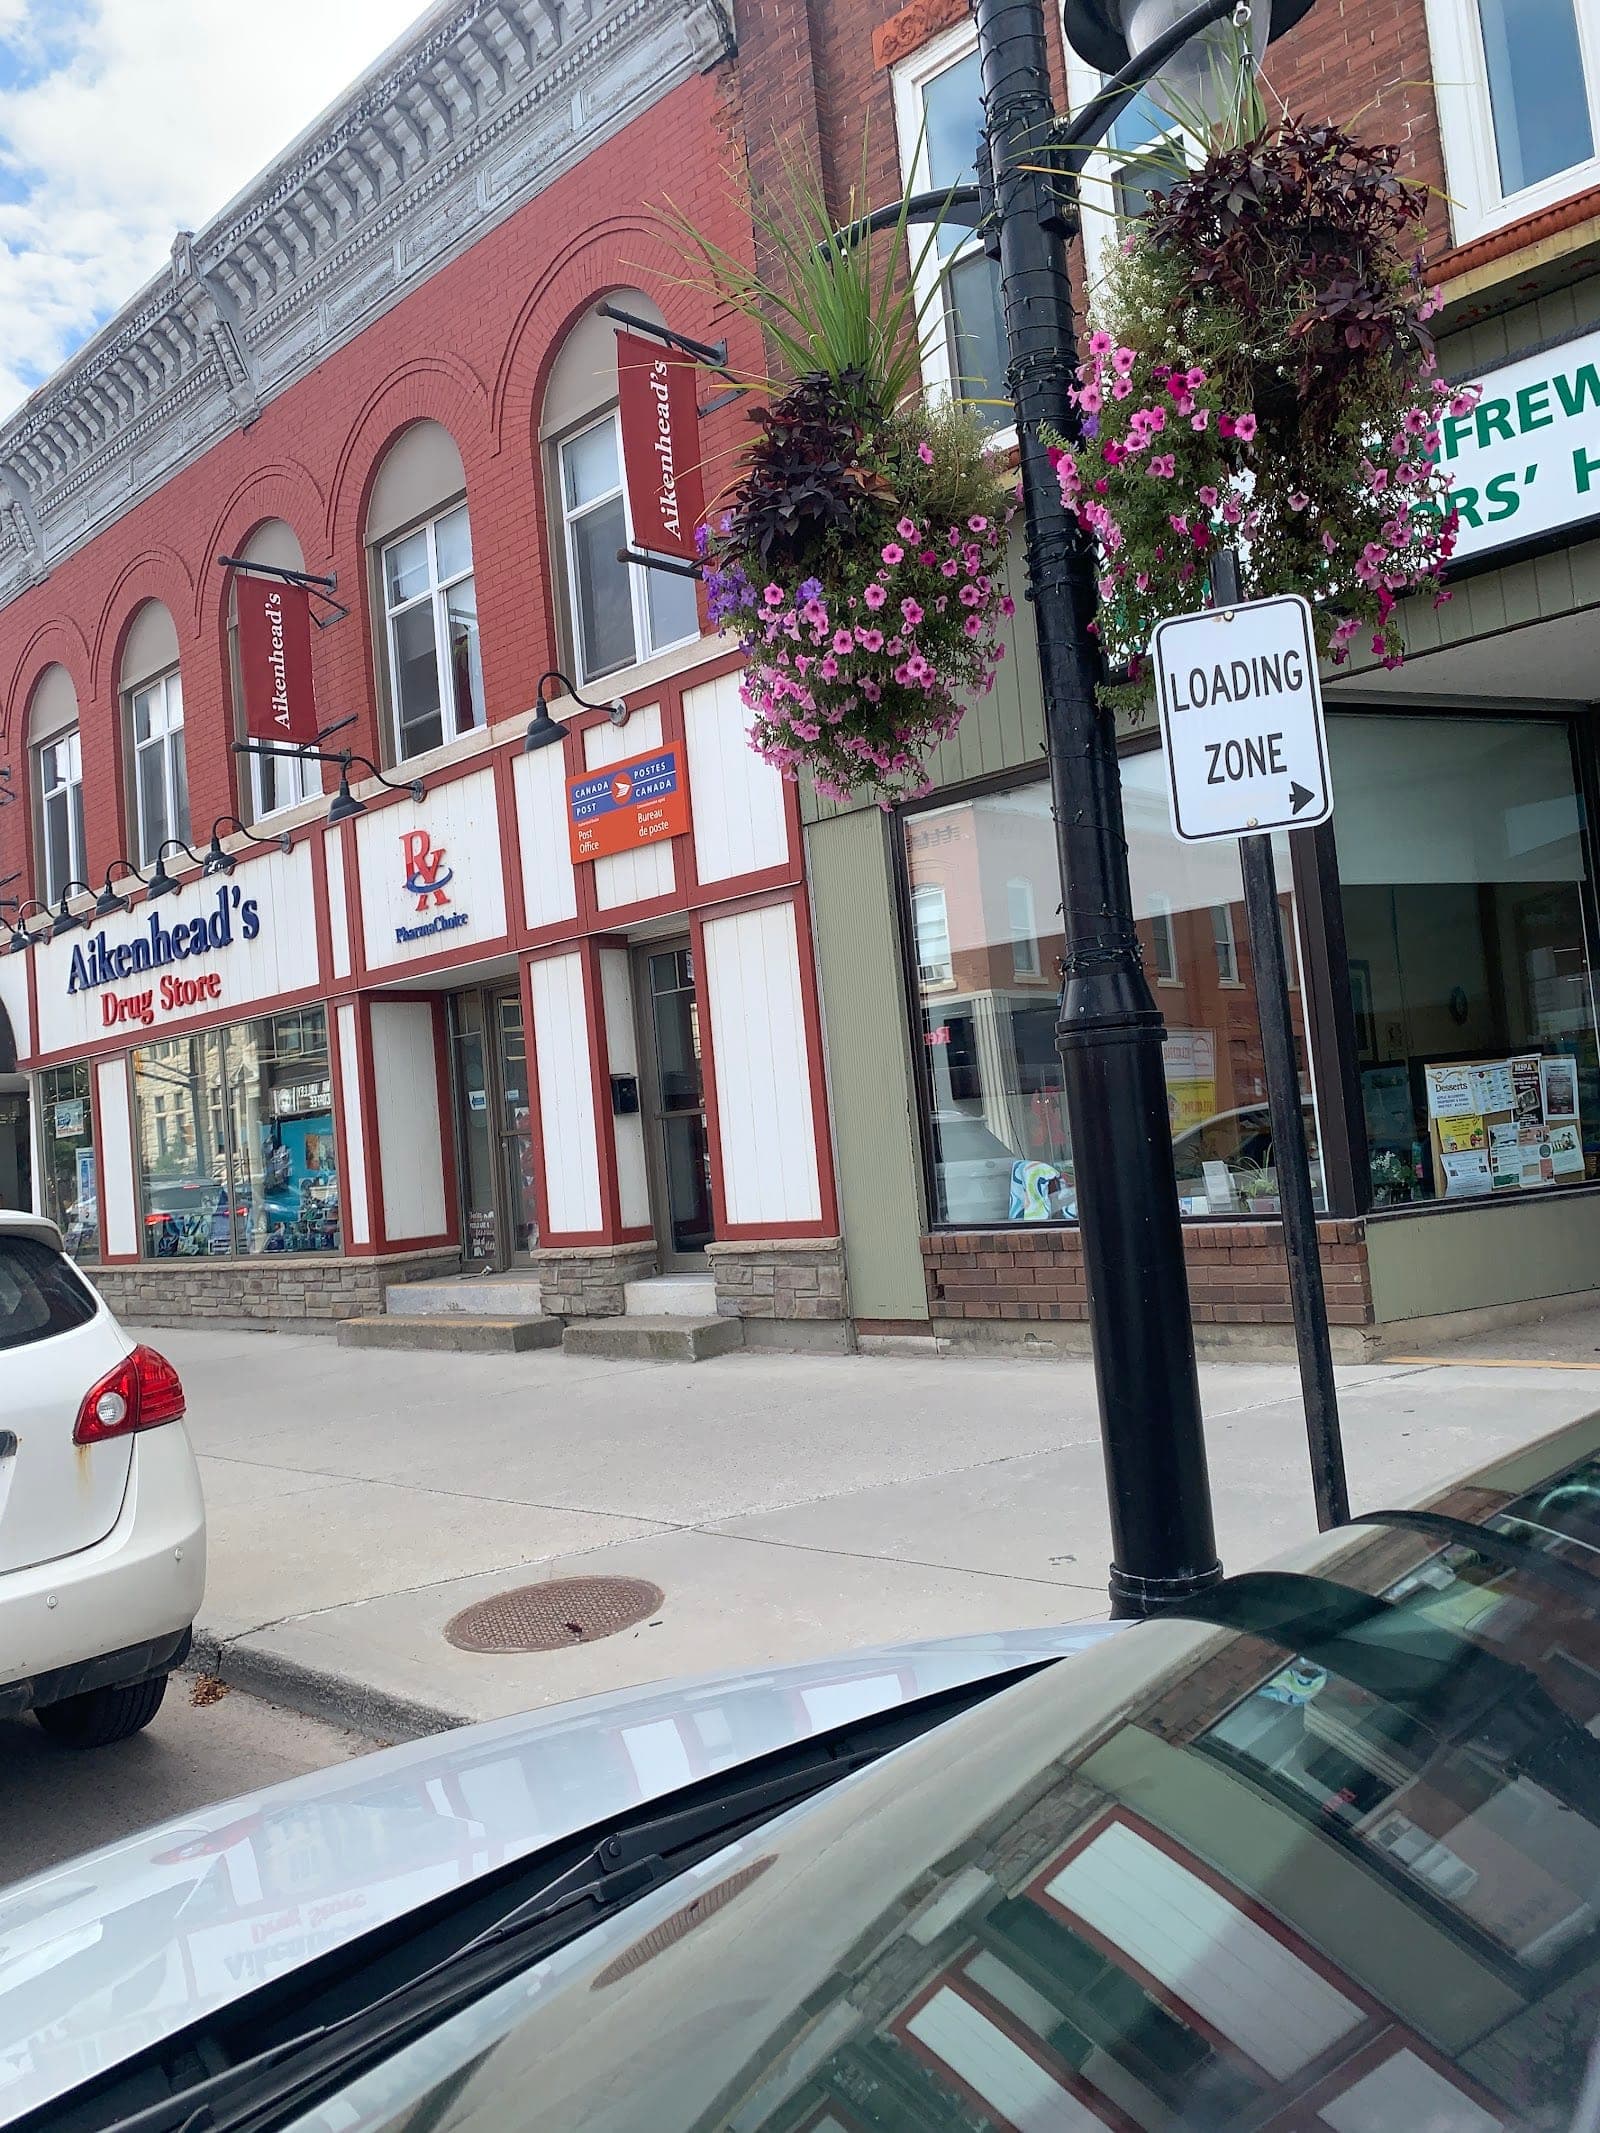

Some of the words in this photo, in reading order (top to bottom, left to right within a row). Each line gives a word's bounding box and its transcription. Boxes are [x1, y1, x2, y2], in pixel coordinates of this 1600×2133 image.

[650, 360, 682, 541] Aikenhead's
[264, 592, 290, 730] Aikenhead's
[1170, 649, 1303, 713] LOADING
[1204, 732, 1288, 785] ZONE
[634, 761, 666, 780] POSTES
[575, 781, 609, 798] CANADA
[635, 780, 672, 797] CANADA
[576, 802, 597, 817] POST
[637, 809, 663, 824] Bureau
[578, 829, 593, 841] Post
[638, 826, 648, 837] de
[649, 820, 669, 836] poste
[579, 840, 600, 854] Office
[395, 912, 469, 944] PharmaChoice
[66, 885, 260, 994] Aikenhead's
[100, 989, 155, 1026] Drug
[159, 972, 222, 1011] Store
[1435, 1082, 1468, 1093] Desserts
